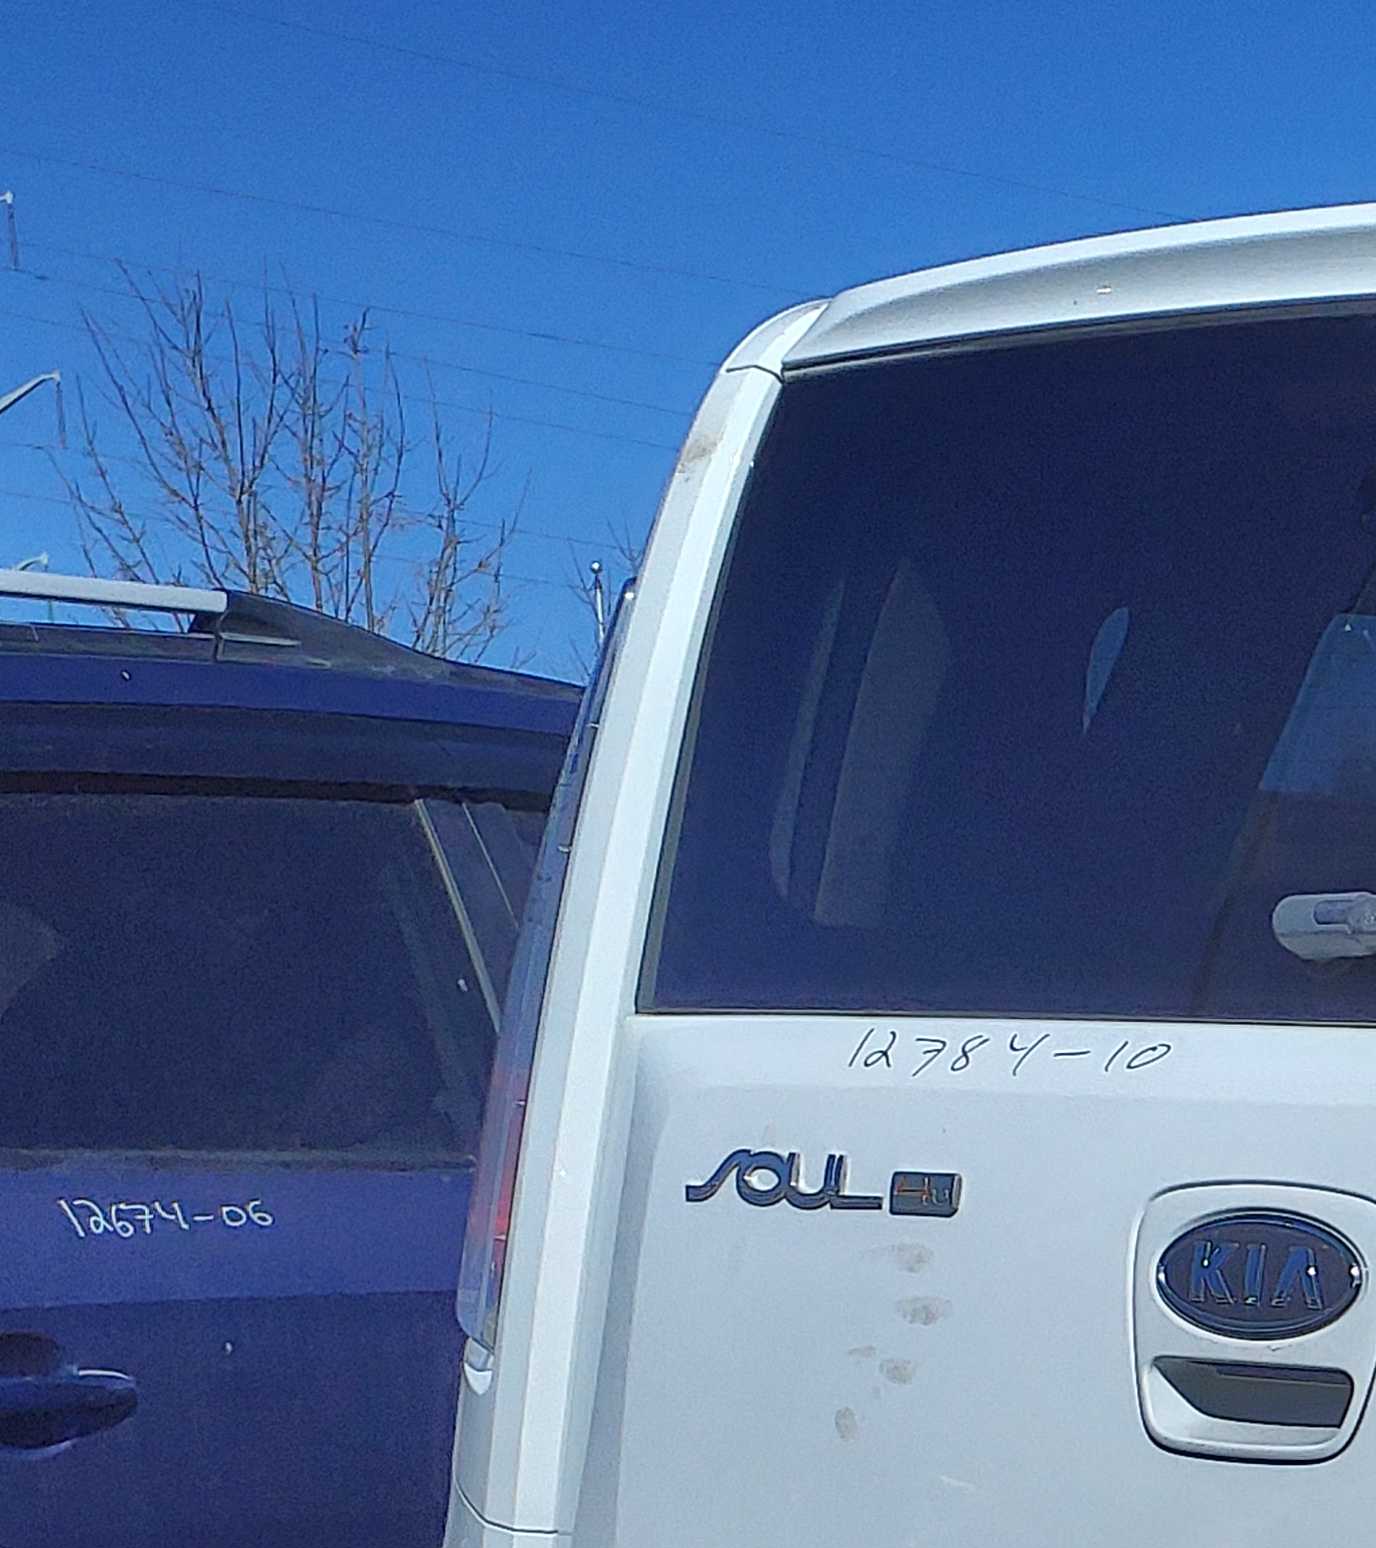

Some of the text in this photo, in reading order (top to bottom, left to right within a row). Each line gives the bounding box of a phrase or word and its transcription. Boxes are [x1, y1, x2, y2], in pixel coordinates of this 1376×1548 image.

[848, 1027, 1174, 1078] 12784-10
[685, 1148, 885, 1211] SOUL
[55, 1198, 275, 1238] 12674-06
[1188, 1239, 1326, 1312] KIA
